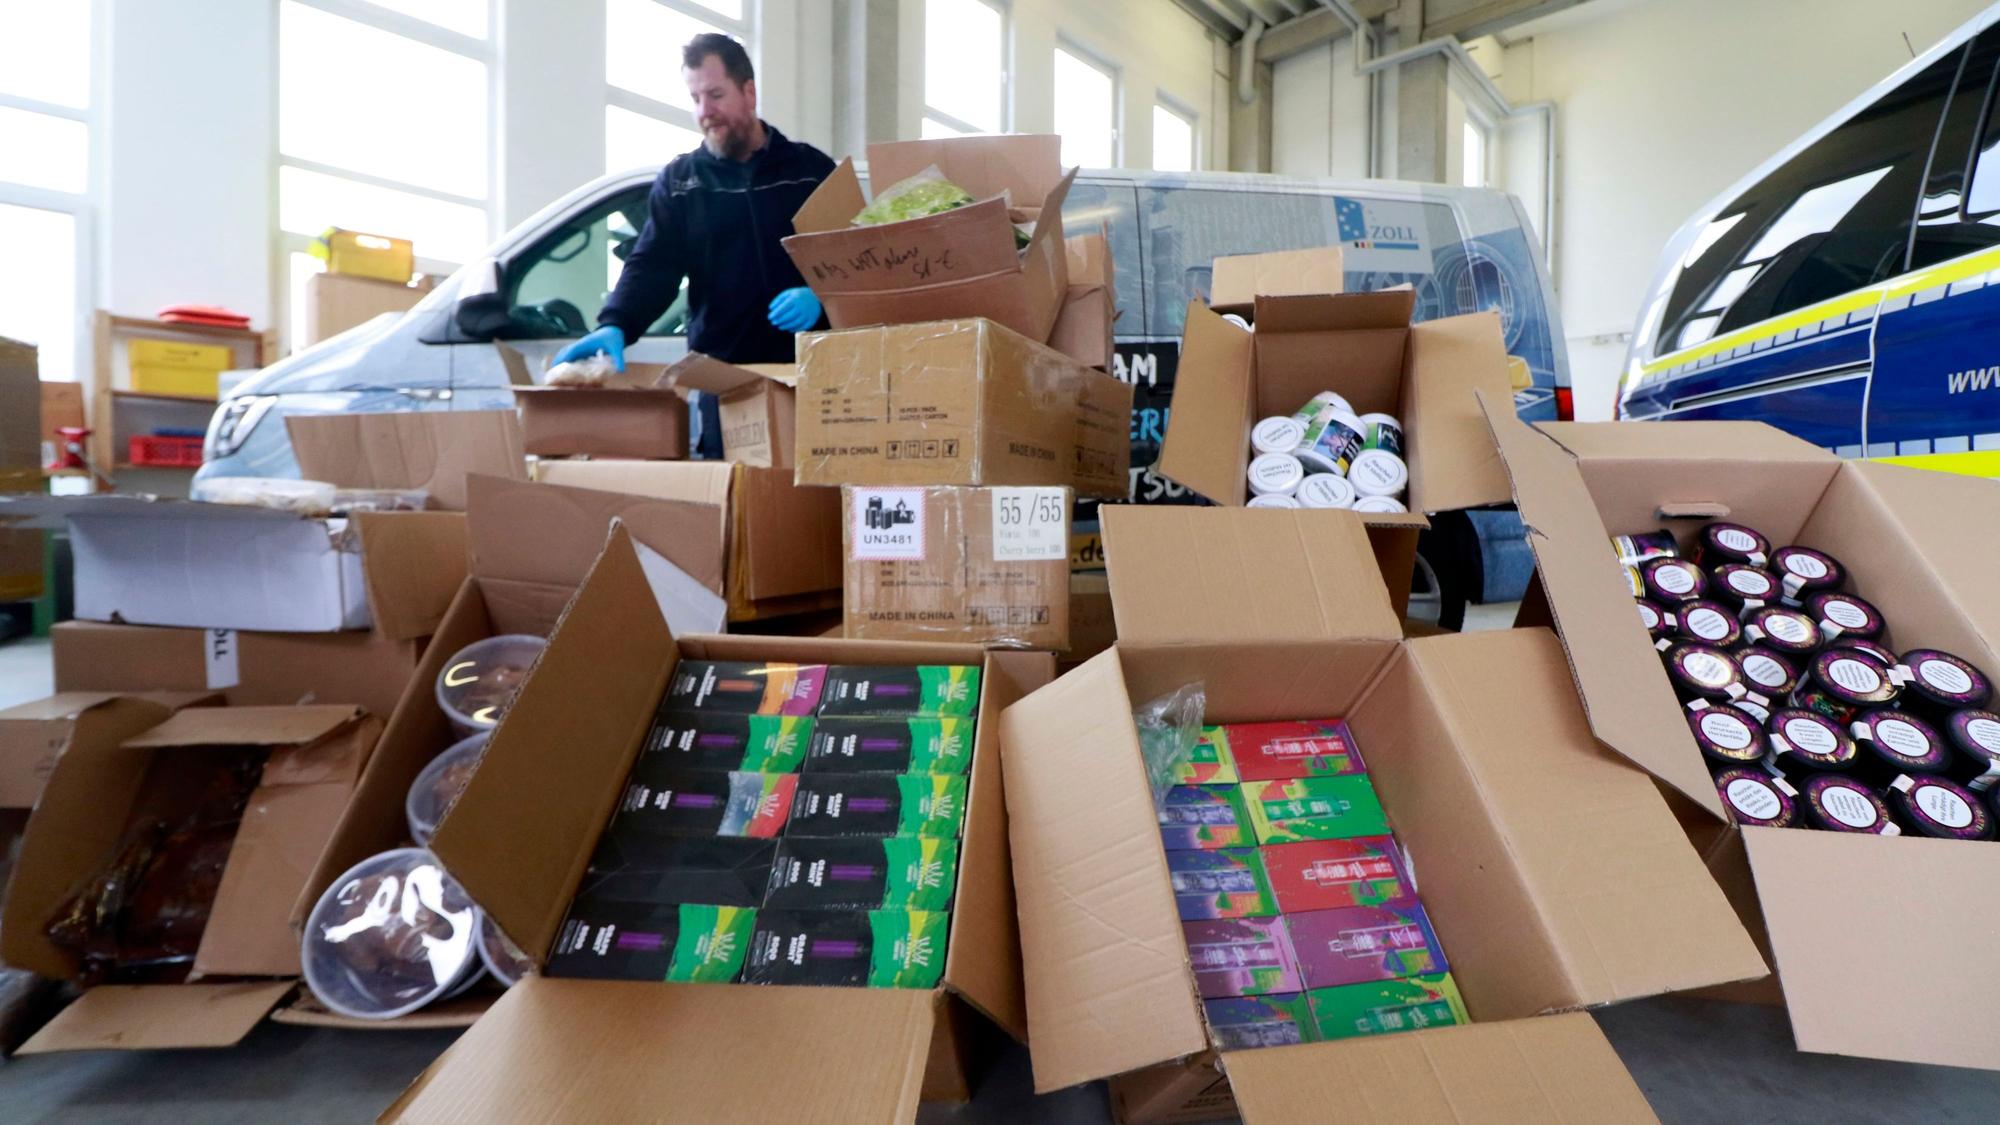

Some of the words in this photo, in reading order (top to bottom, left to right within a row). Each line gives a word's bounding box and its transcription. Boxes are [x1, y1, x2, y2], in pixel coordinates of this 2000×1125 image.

[1370, 226, 1418, 241] ZOLL
[812, 448, 836, 456] MADE
[839, 448, 848, 456] IN
[850, 446, 878, 455] CHINA
[1000, 496, 1021, 525] 55
[864, 535, 912, 544] UN3481
[869, 612, 900, 620] MADE
[904, 612, 916, 620] IN
[919, 612, 955, 620] CHINA
[807, 862, 818, 884] MINT
[813, 858, 826, 887] GRAPE
[787, 936, 798, 962] MINT
[794, 933, 806, 966] GRAPE
